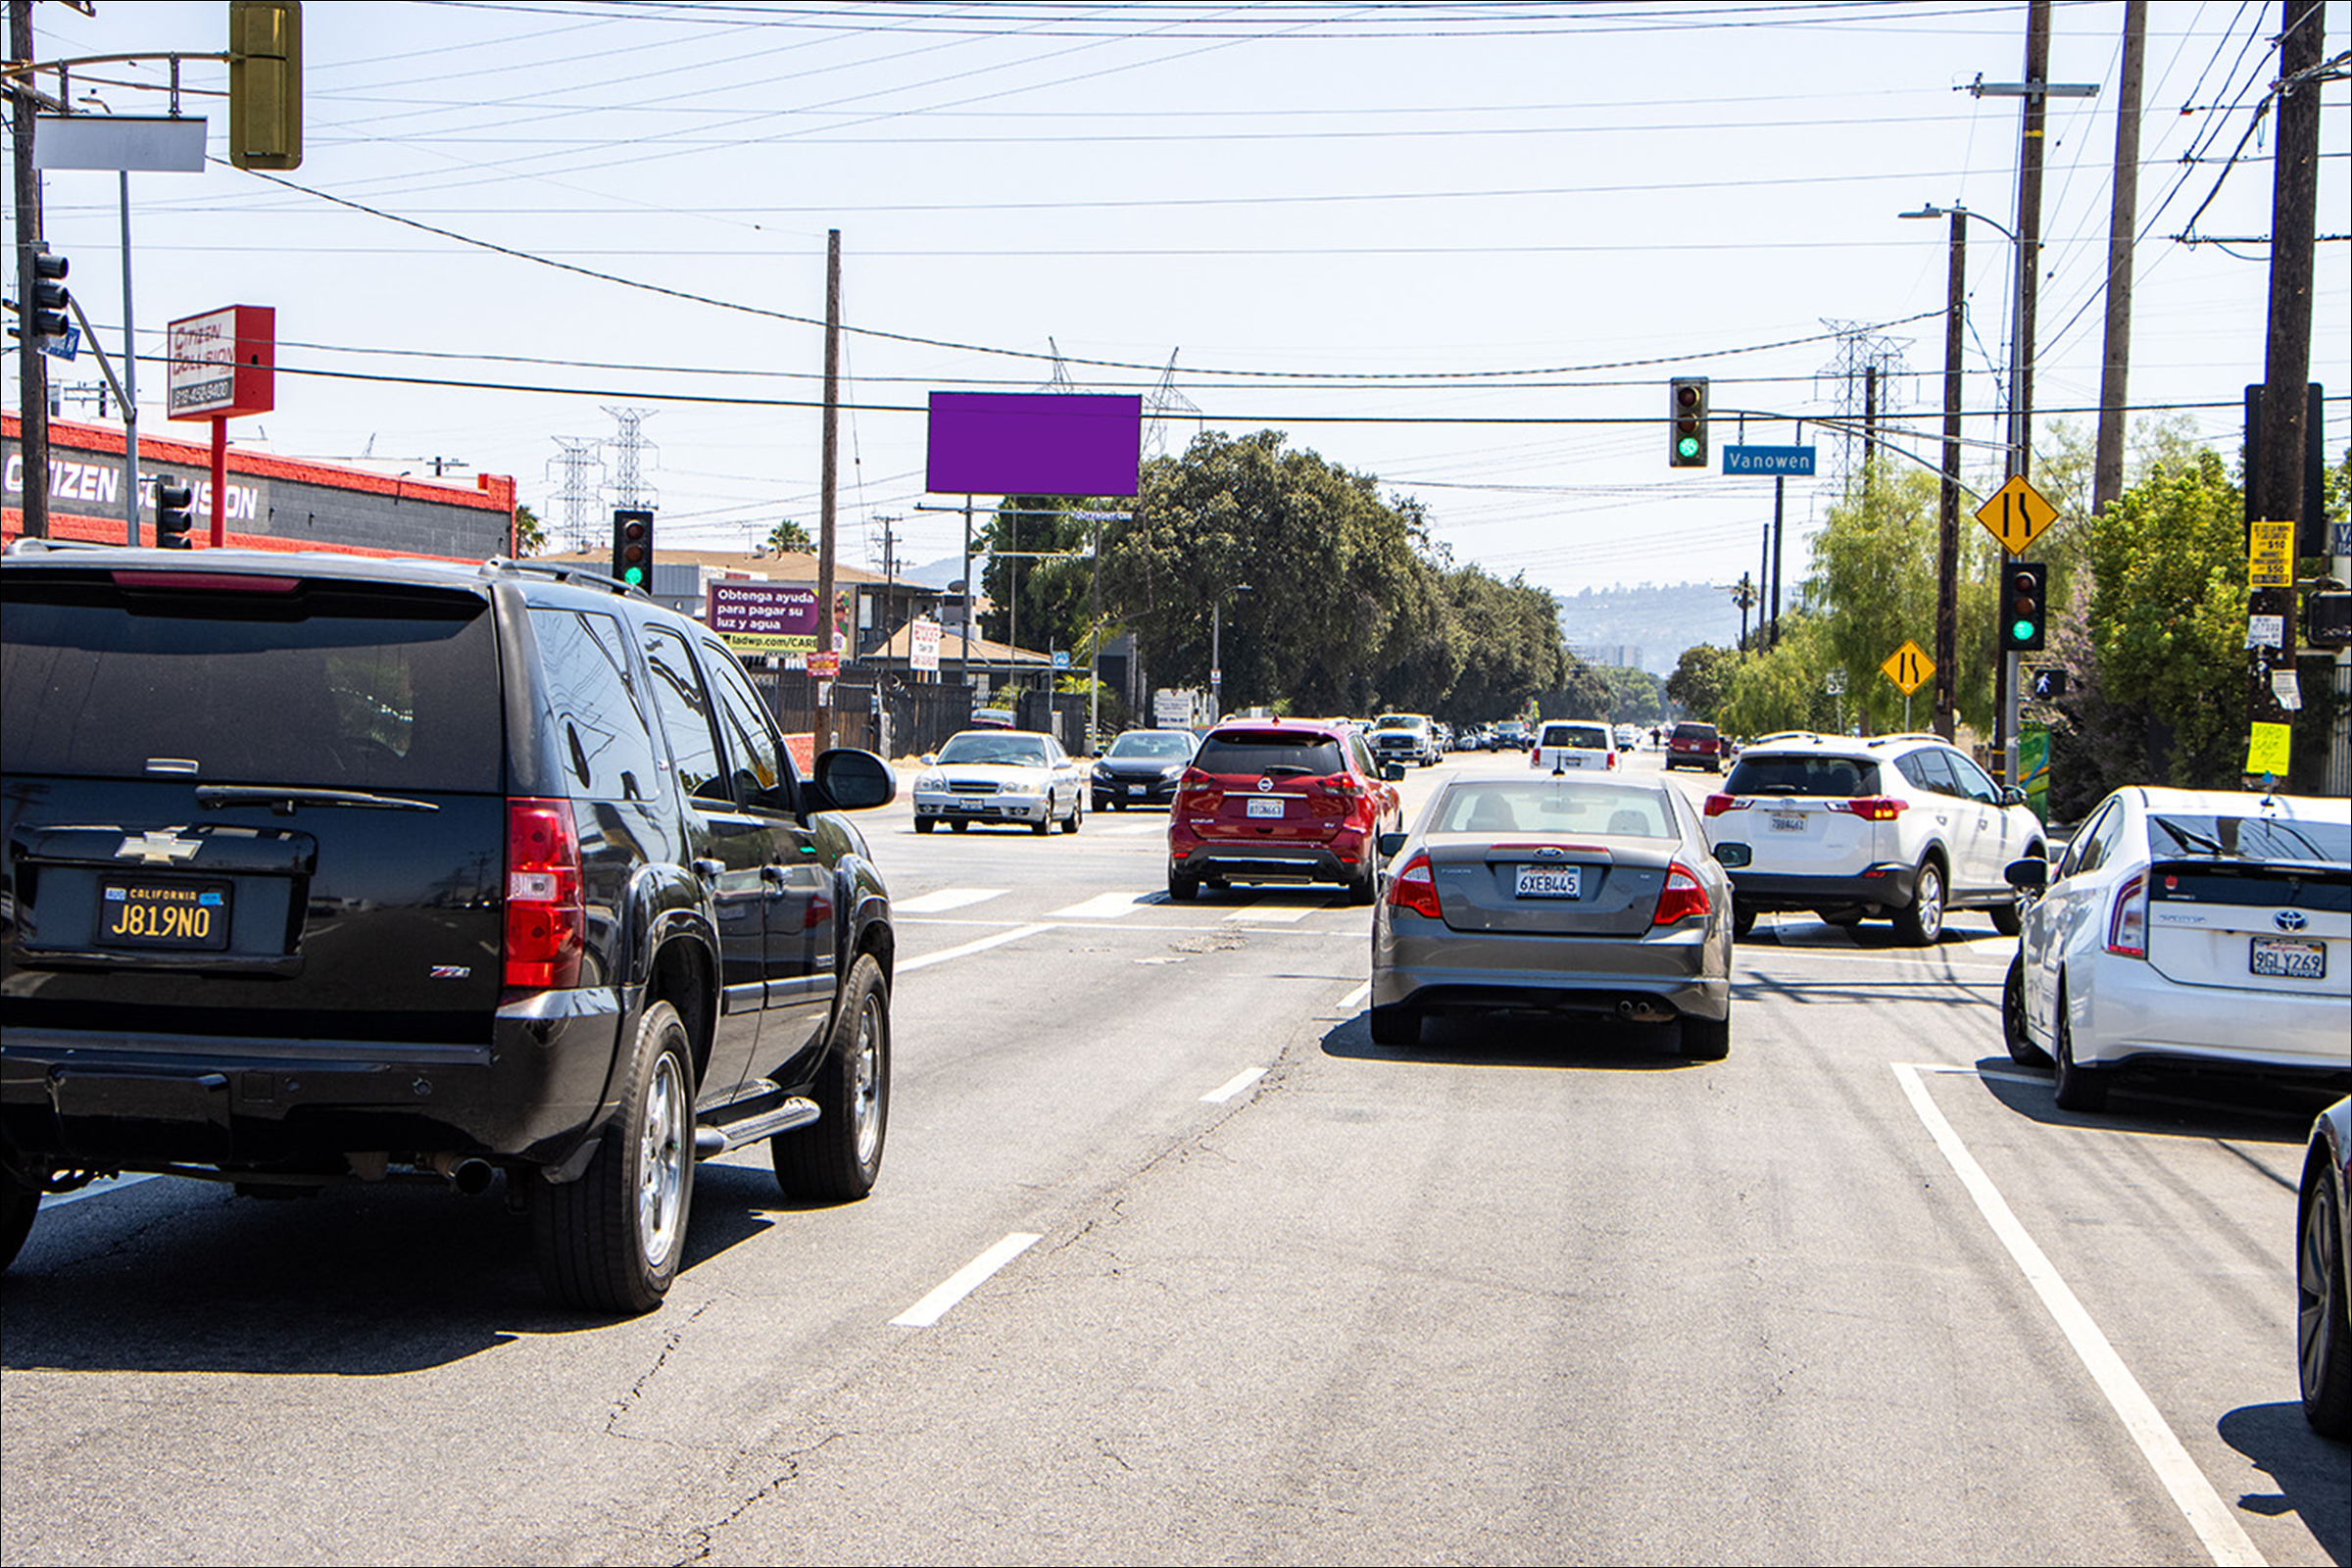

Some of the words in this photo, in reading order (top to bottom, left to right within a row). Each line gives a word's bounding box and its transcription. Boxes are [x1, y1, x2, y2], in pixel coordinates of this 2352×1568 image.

[1730, 453, 1810, 468] Vanowen
[717, 589, 772, 604] Obtenga
[775, 592, 814, 605] ayuda
[717, 605, 746, 615] para
[749, 606, 786, 617] pagar
[788, 608, 804, 616] su
[716, 617, 736, 628] luz
[738, 619, 747, 630] y
[750, 620, 781, 631] agua
[1519, 875, 1577, 893] 6XEB445
[129, 888, 197, 901] CALIFORNIA
[2255, 951, 2322, 970] 9GLY269
